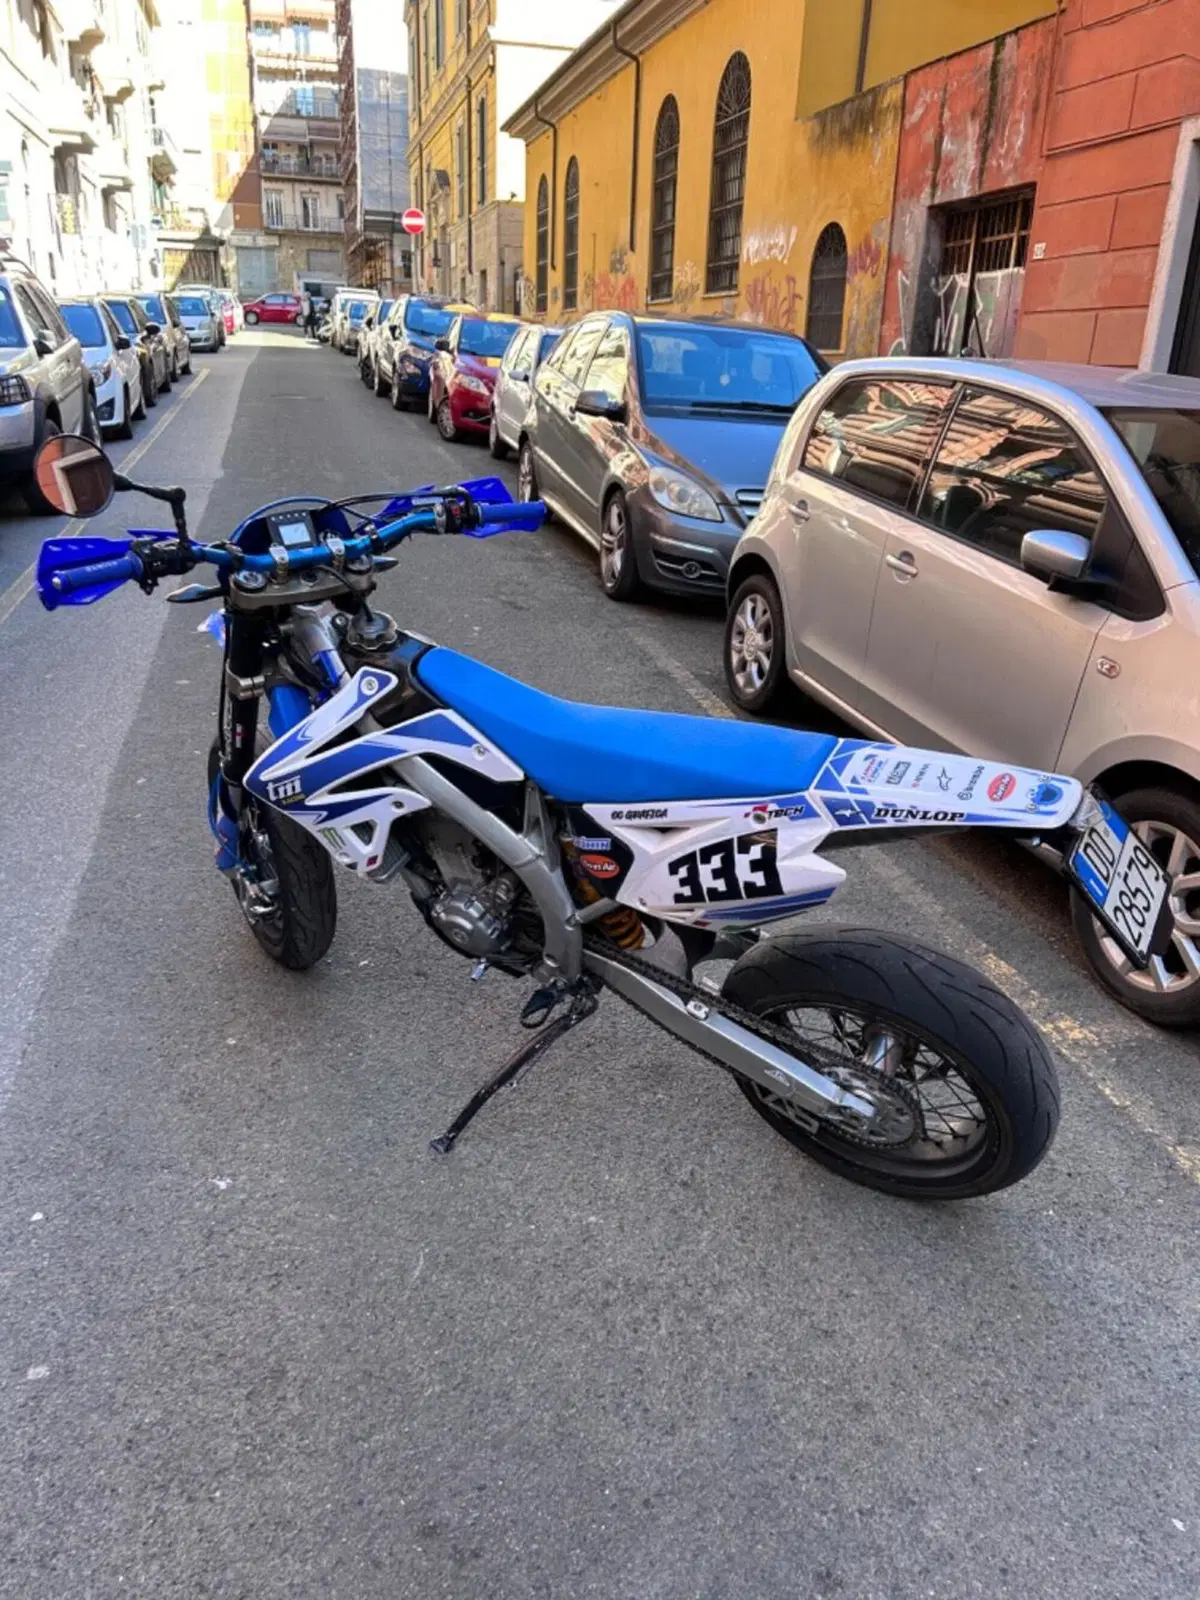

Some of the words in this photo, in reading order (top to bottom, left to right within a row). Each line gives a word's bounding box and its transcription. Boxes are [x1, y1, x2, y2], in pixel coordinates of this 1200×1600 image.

[875, 808, 965, 822] DUNLOP
[668, 827, 785, 904] 333
[1083, 826, 1116, 882] DD
[1113, 845, 1160, 948] 28579
